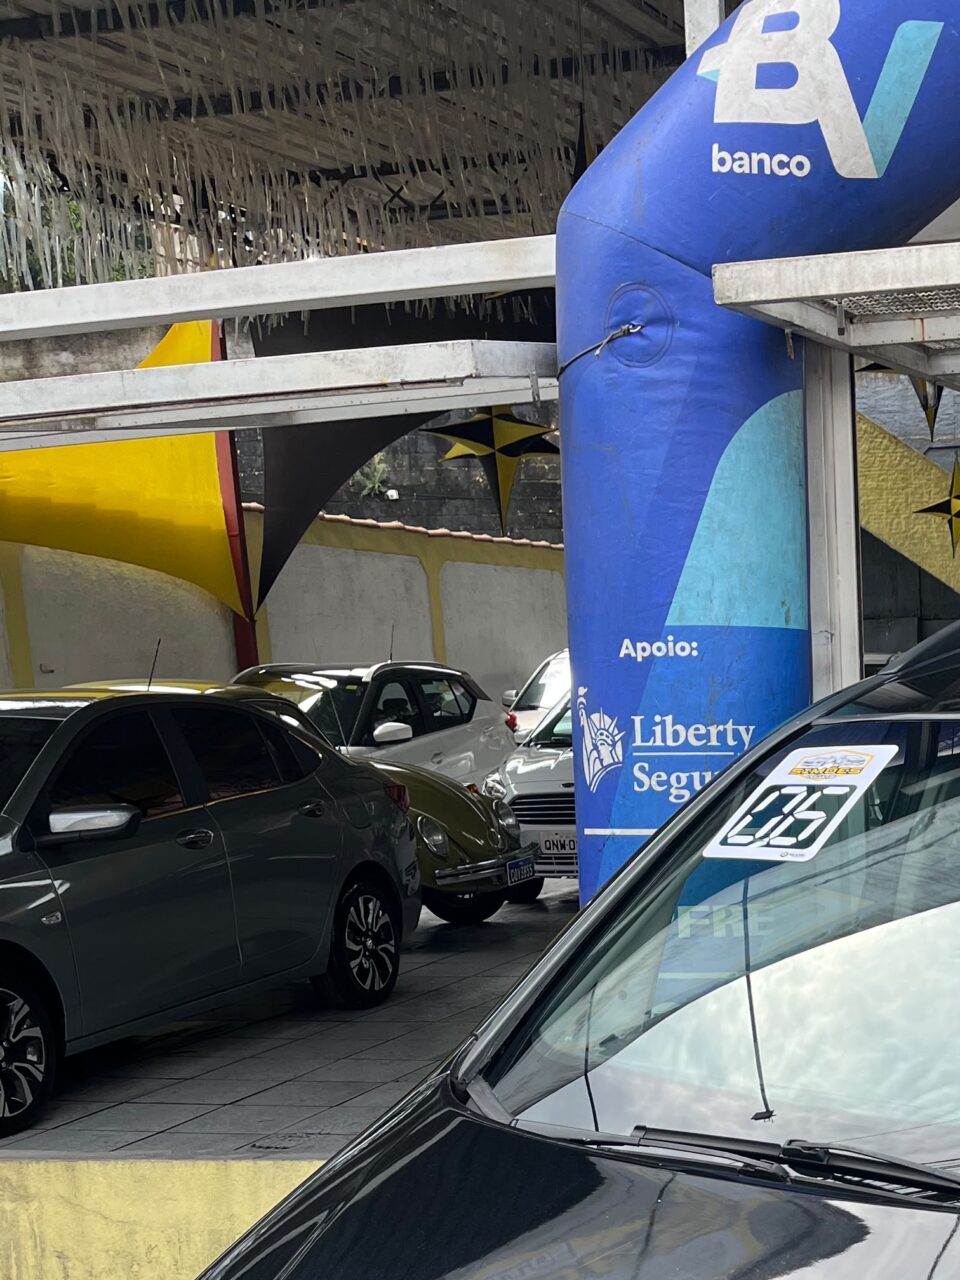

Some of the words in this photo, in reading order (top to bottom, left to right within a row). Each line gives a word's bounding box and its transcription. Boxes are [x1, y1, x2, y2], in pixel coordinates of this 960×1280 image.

[697, 0, 944, 179] BV
[711, 143, 811, 178] banco
[618, 634, 699, 662] Apoio:
[630, 713, 756, 751] Liberty
[632, 761, 718, 804] Segu
[726, 785, 850, 846] 06
